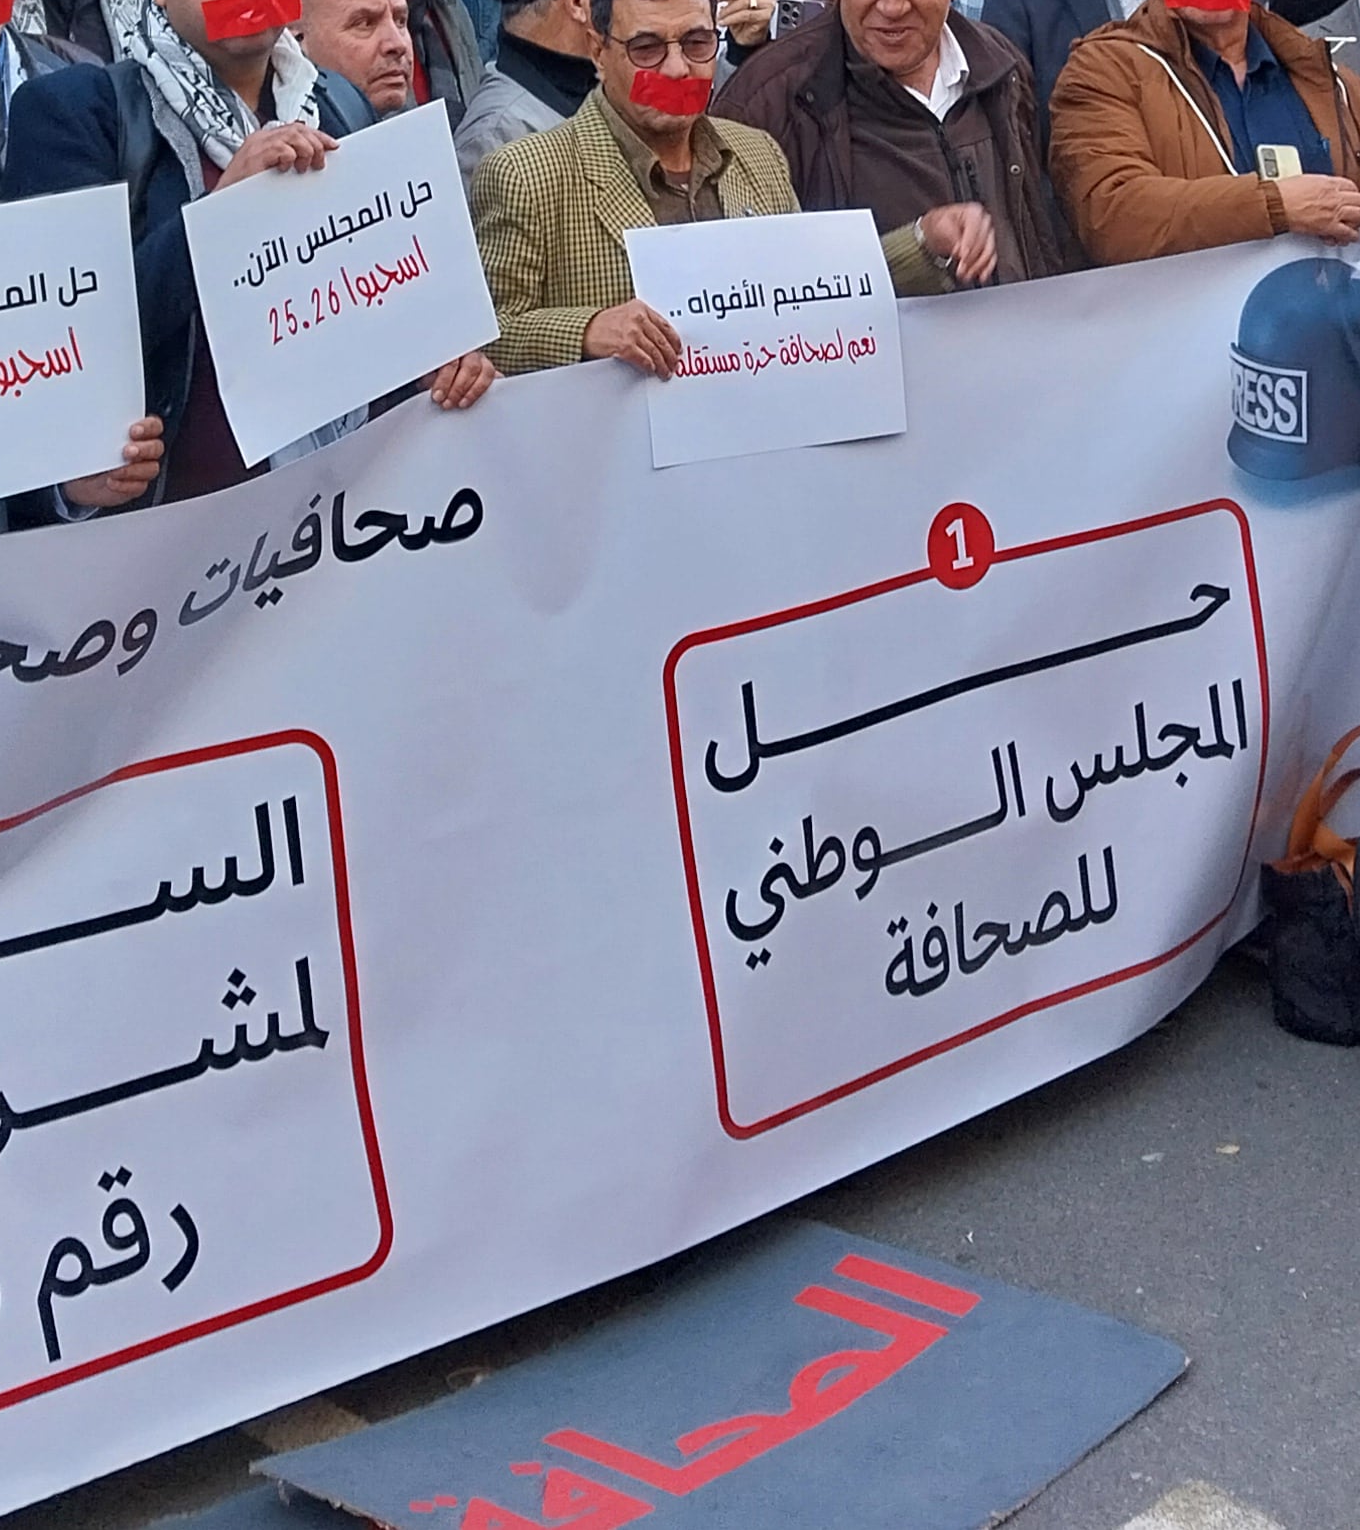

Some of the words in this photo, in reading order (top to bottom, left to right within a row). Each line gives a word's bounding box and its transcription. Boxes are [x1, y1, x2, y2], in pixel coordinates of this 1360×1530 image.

[296, 191, 393, 264] المجلس
[400, 180, 433, 219] حل
[58, 266, 99, 308] حل
[234, 236, 289, 288] الآن..
[339, 233, 431, 308] اسحبوا
[859, 272, 873, 296] لا
[269, 280, 340, 346] 25.26
[687, 279, 766, 320] الأفواه
[773, 274, 852, 316] لتكميم
[744, 341, 777, 376] حرة
[778, 327, 844, 366] لصحافة
[847, 325, 877, 365] نعم
[1231, 363, 1298, 434] RESS
[177, 484, 485, 627] صحافيات
[946, 518, 976, 571] 1
[703, 578, 1232, 795] حل
[1043, 677, 1251, 825] المجلس
[724, 740, 1029, 973] الوطني
[884, 846, 1120, 1000] للصحافة
[37, 1165, 200, 1364] رقم
